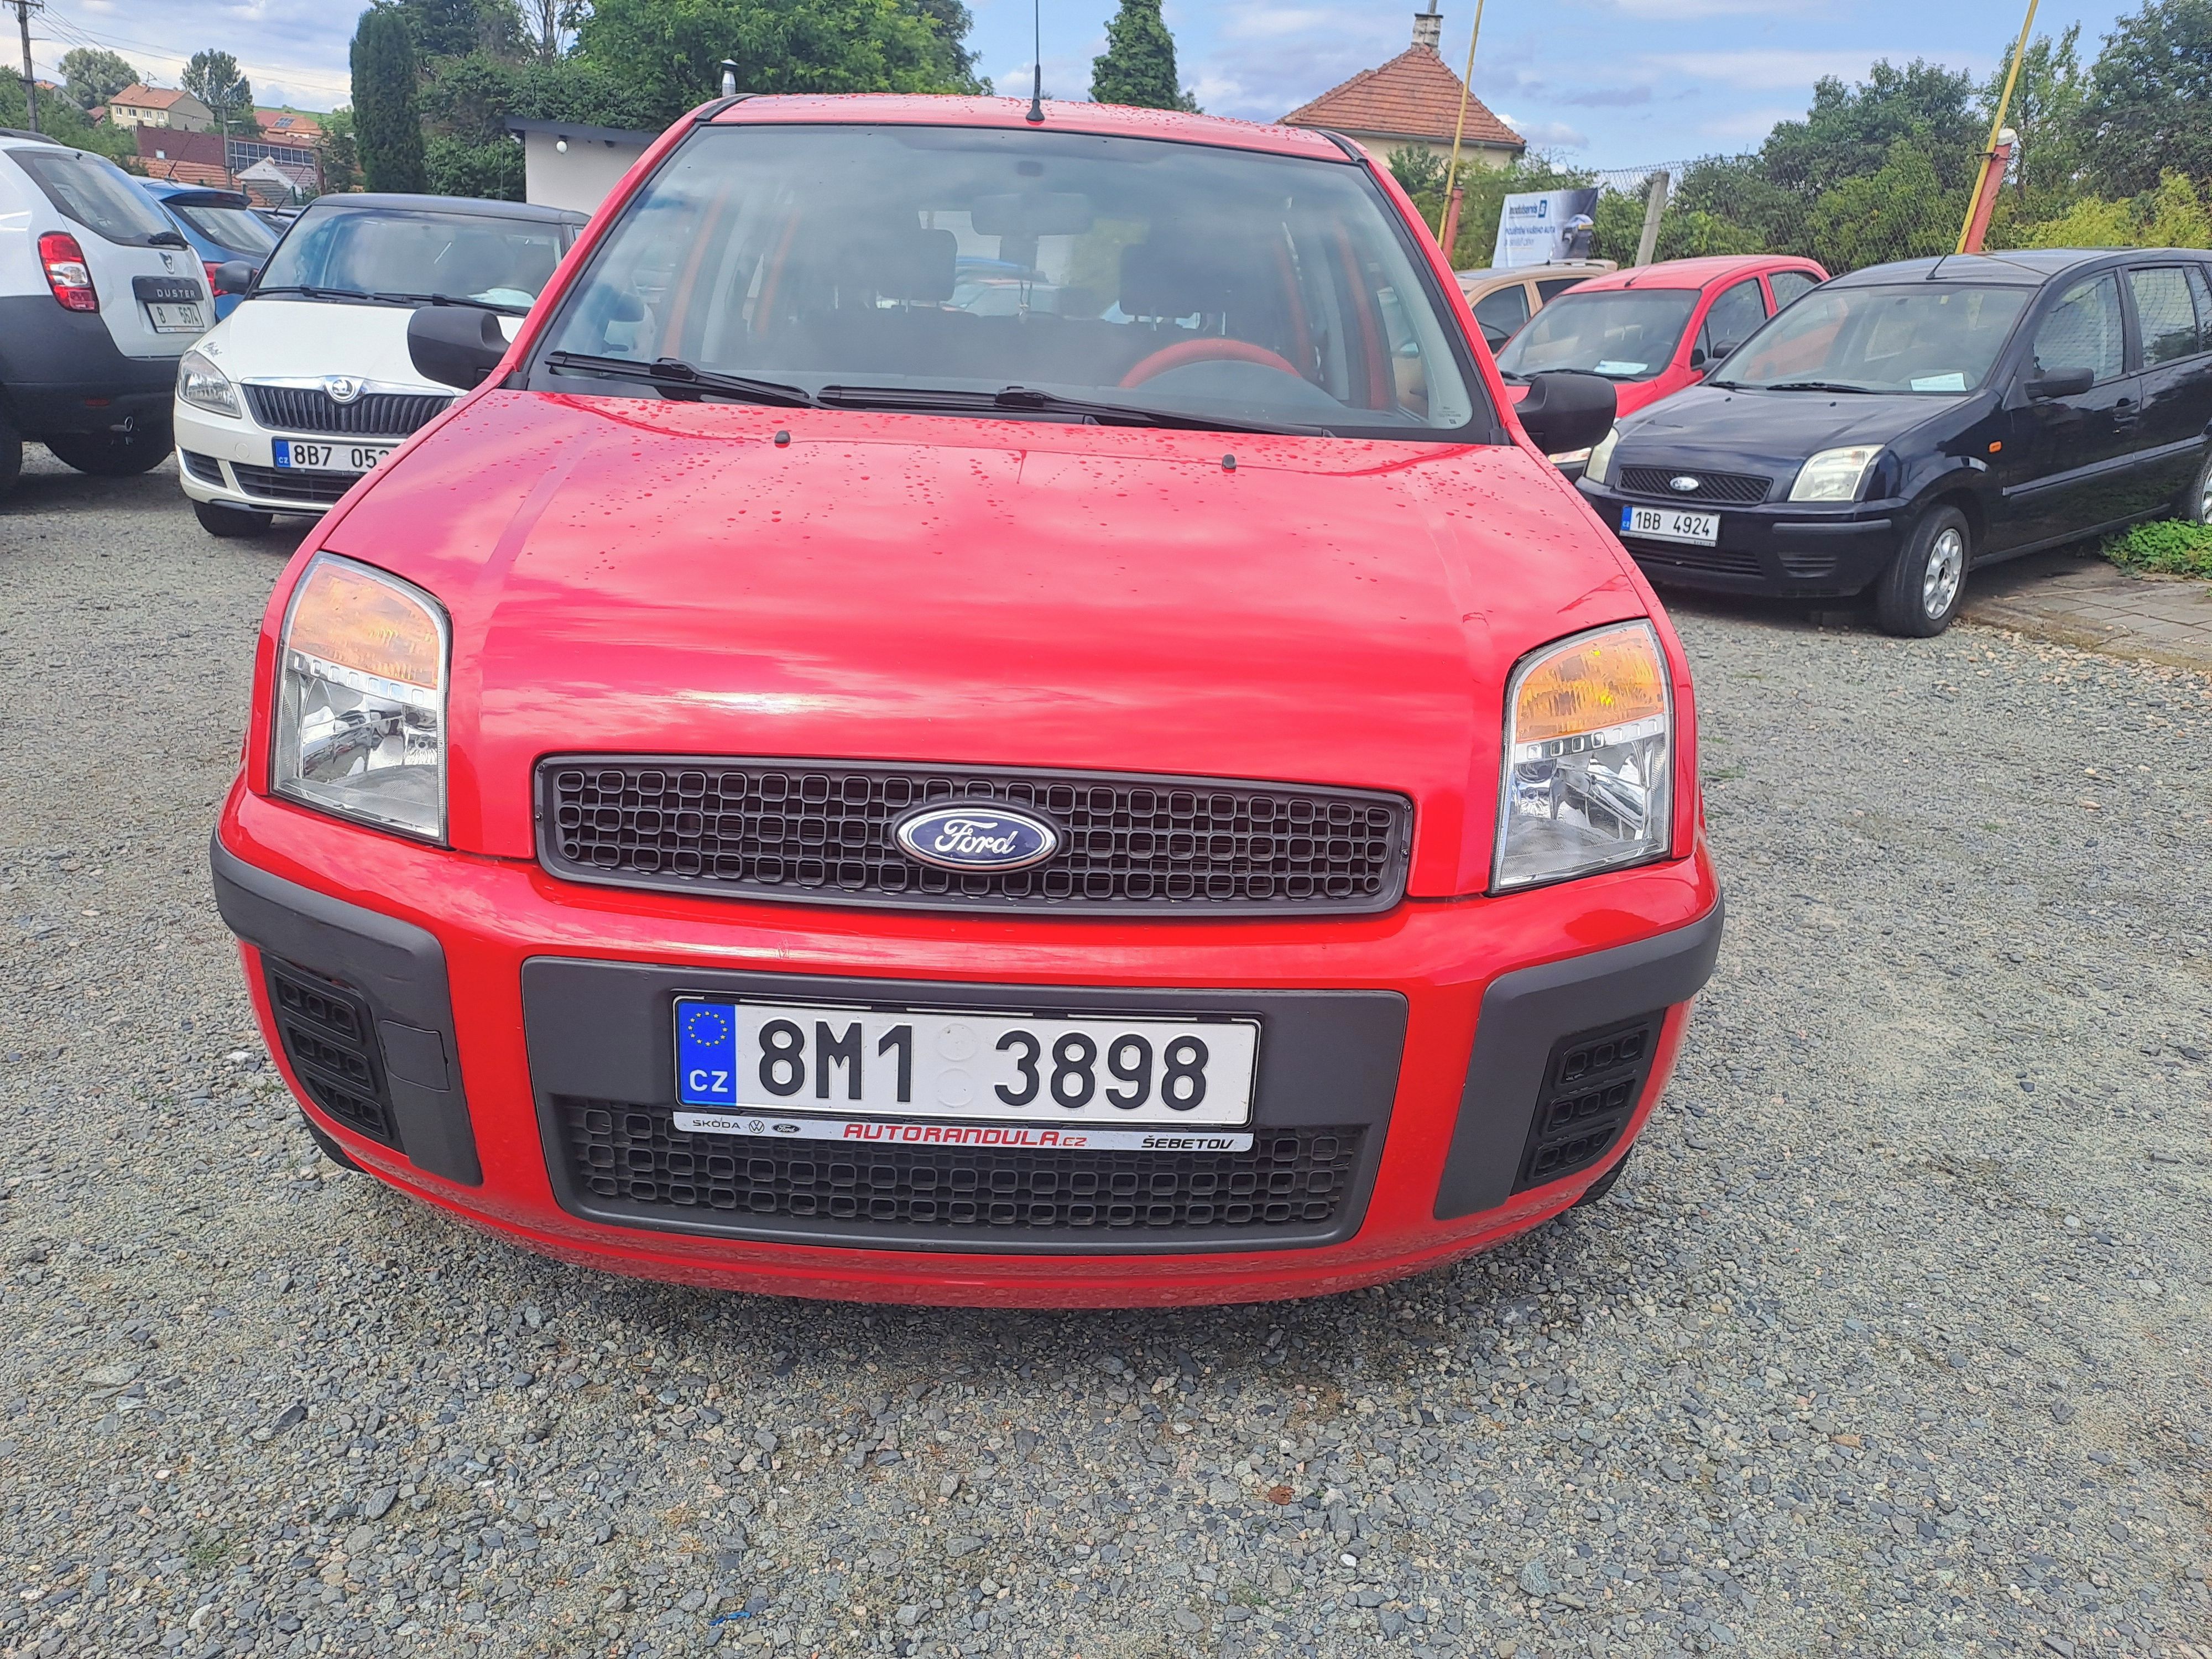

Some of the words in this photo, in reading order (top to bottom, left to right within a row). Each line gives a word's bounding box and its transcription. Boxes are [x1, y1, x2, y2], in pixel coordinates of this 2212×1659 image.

[156, 289, 195, 298] DUSTER
[156, 306, 166, 324] B
[179, 306, 199, 325] 5674
[294, 445, 332, 466] 8B7
[1636, 512, 1661, 530] 1BB
[1673, 515, 1710, 536] 4924
[935, 819, 1019, 854] Ford
[758, 1019, 913, 1103] 8M1
[994, 1027, 1209, 1110] 3898
[689, 1070, 728, 1093] CZ
[1141, 1135, 1234, 1149] ŠEBETOV
